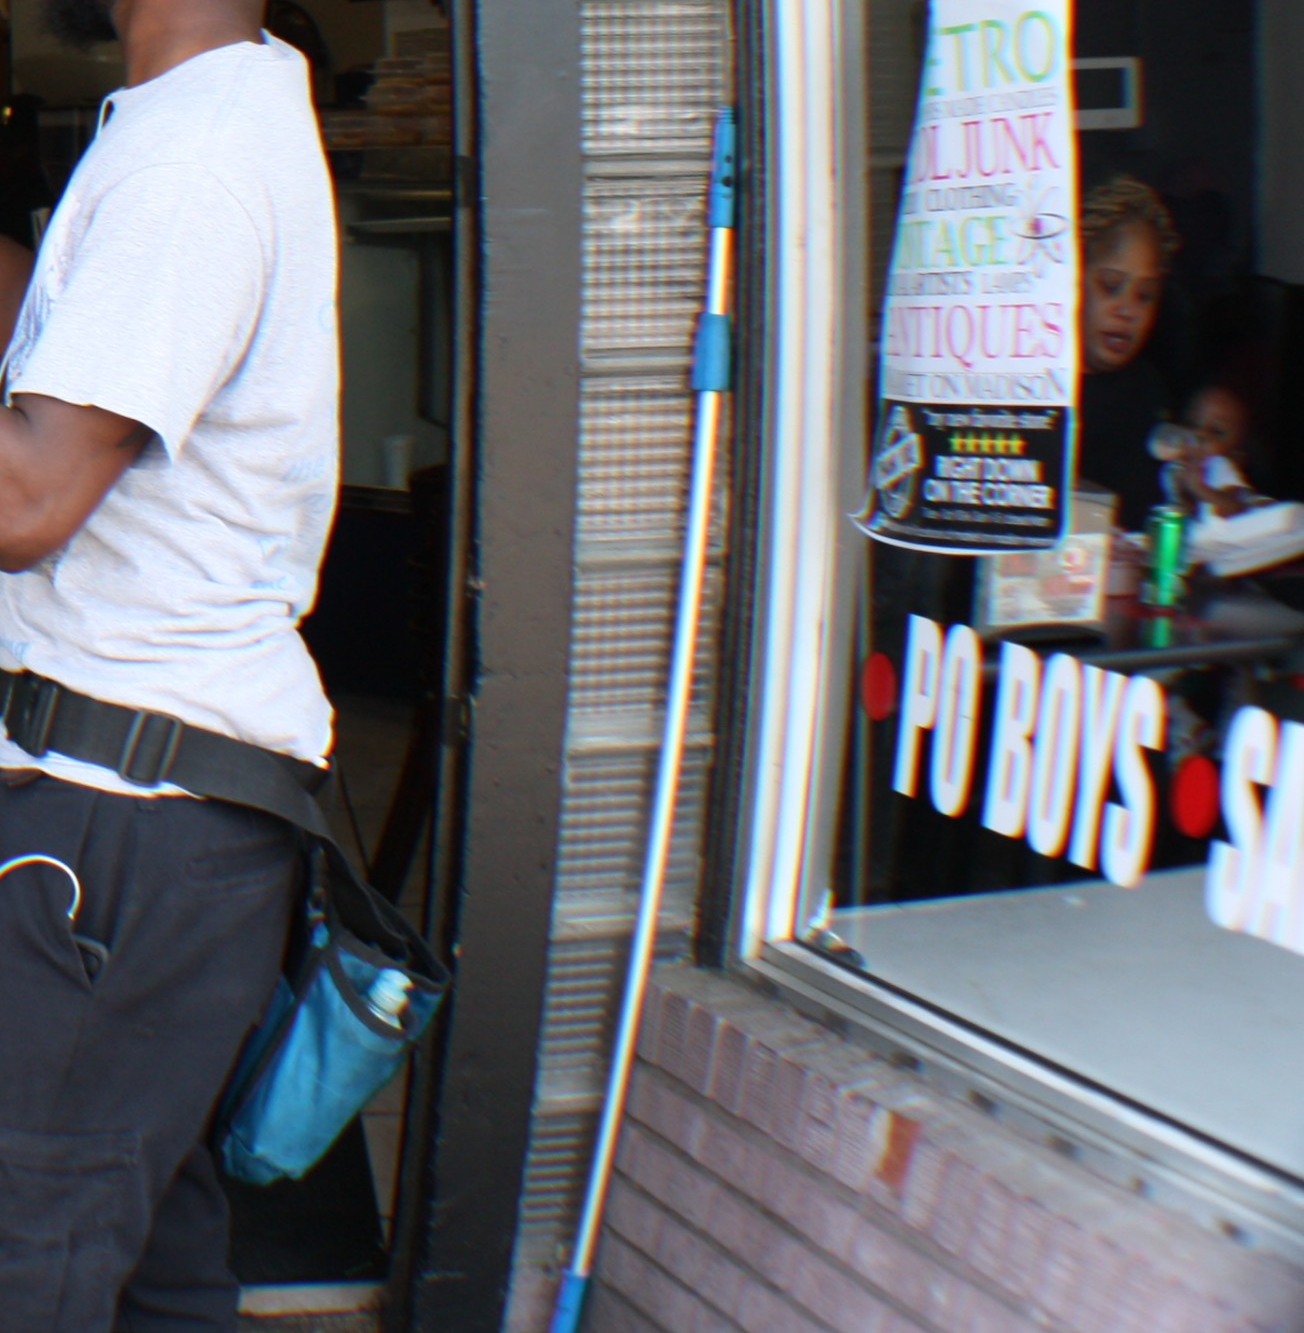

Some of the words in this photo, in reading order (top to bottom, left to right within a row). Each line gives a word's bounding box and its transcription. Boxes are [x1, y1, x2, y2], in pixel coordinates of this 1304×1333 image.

[956, 111, 1062, 179] JUNK
[893, 613, 980, 819] PO
[981, 640, 1168, 889] BOYS
